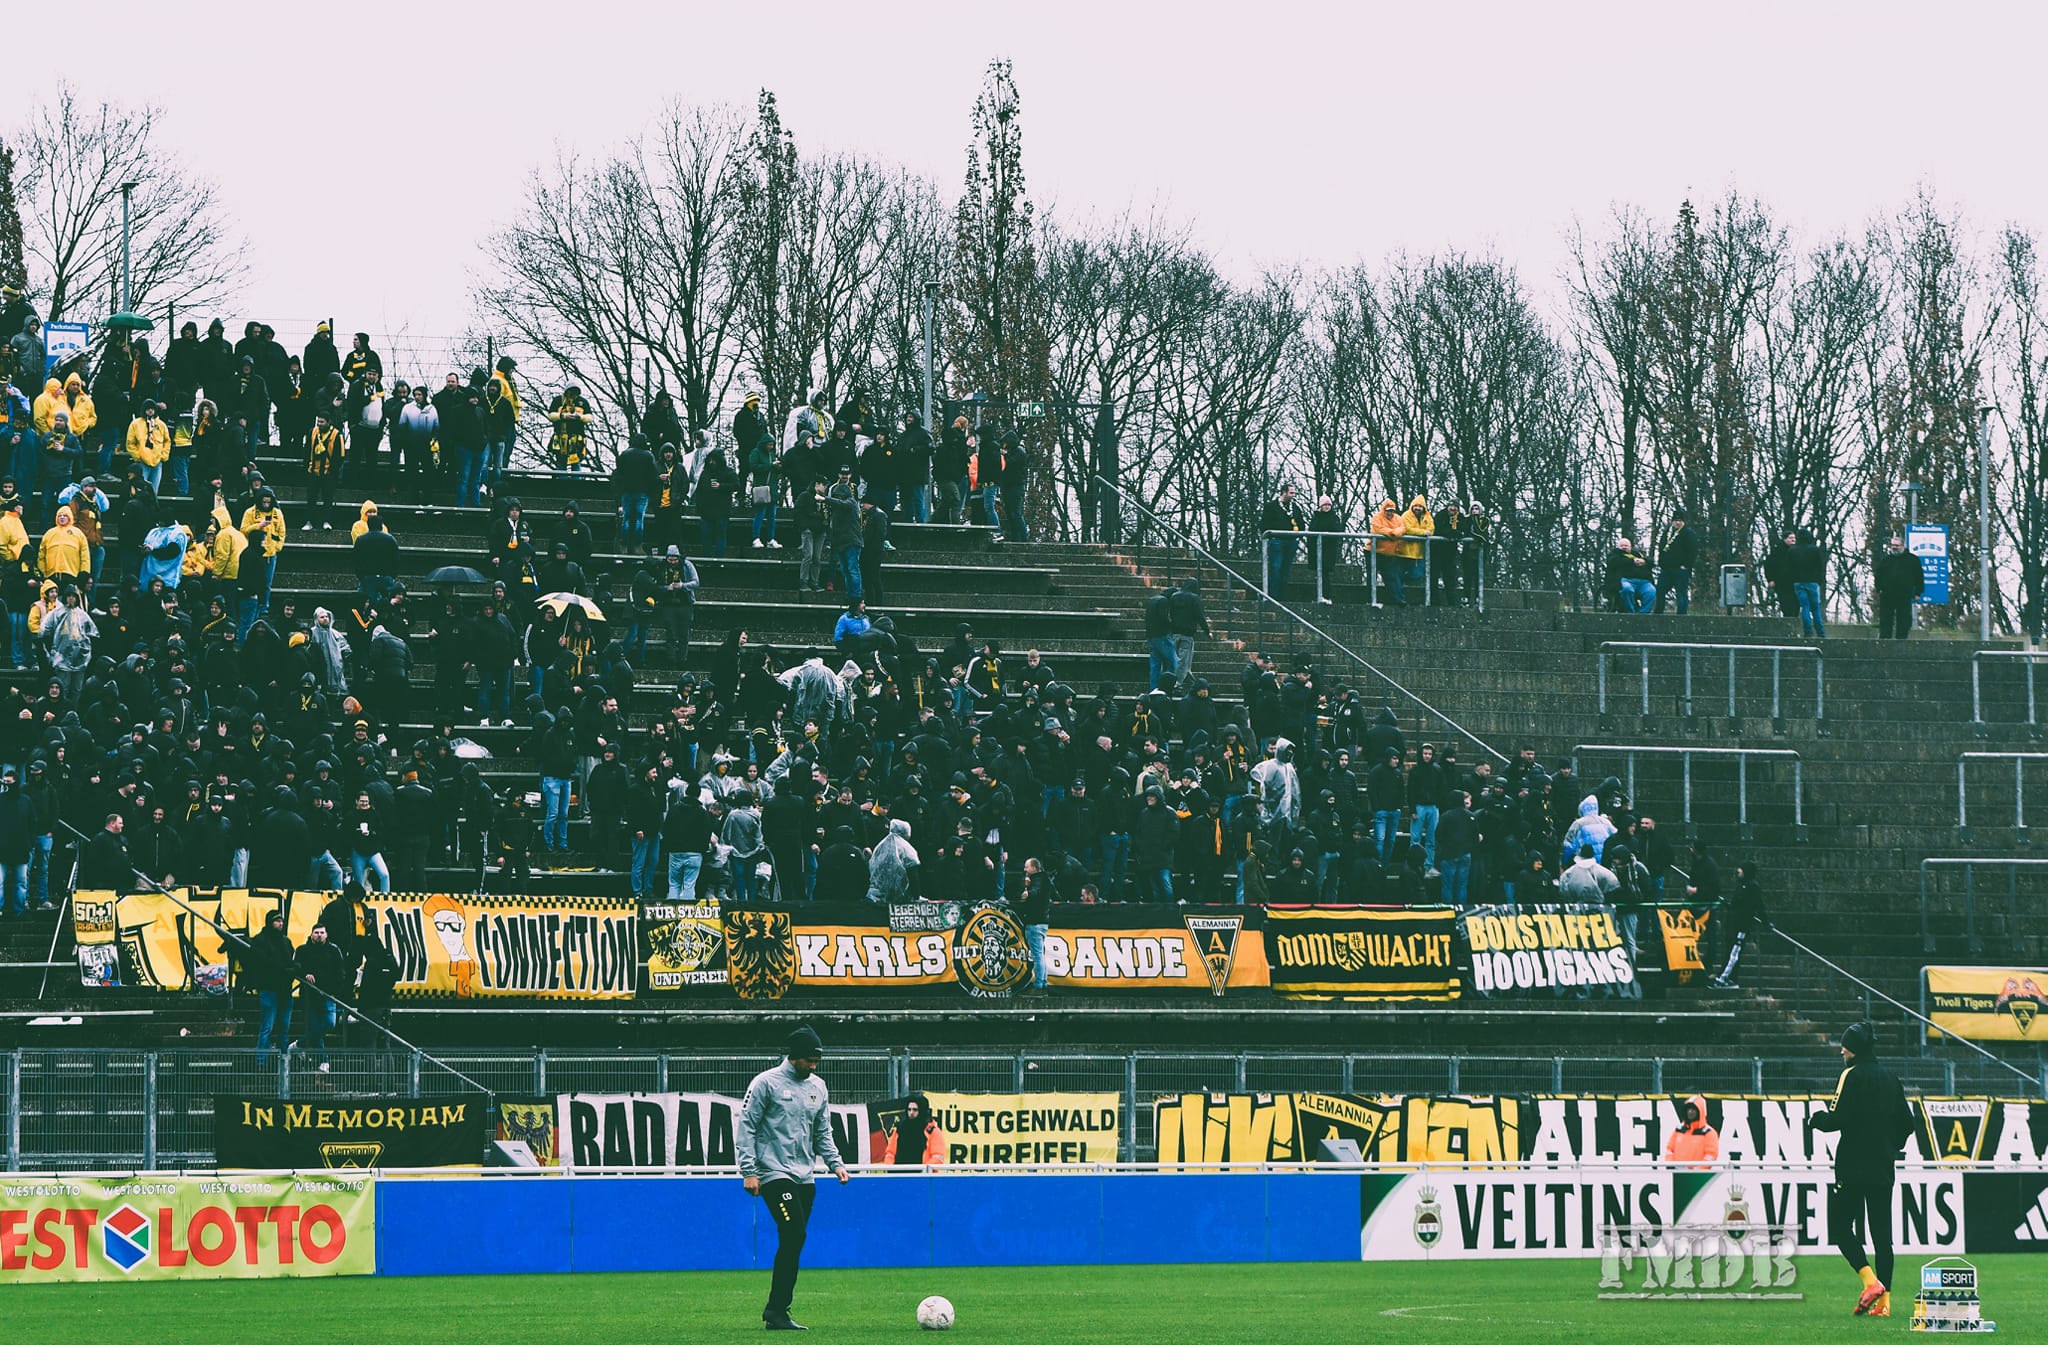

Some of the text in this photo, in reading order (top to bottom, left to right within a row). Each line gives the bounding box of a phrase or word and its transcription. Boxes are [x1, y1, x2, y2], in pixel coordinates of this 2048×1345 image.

[645, 904, 720, 919] FÜR STADT
[1192, 919, 1238, 929] ALEMANNIA
[1208, 931, 1226, 952] A
[1466, 913, 1623, 951] BOXSTAFFEL
[475, 913, 637, 994] CONNECTION
[796, 935, 945, 977] KARLS
[1045, 936, 1187, 978] BANDE
[1277, 933, 1451, 967] DOM WACHT
[653, 973, 681, 986] UND
[1472, 947, 1633, 991] HOOLIGANS
[1934, 996, 1994, 1010] Tivoli Tigers
[929, 1104, 1115, 1134] HÜRTGENWALD
[1299, 1095, 1374, 1127] ALEMANNIA
[1929, 1103, 1984, 1113] ALEMANNIA
[328, 1146, 376, 1156] Alemannia
[1947, 1120, 1968, 1152] A
[1453, 1183, 1663, 1249] VELTINS
[1761, 1182, 1958, 1246] VENS
[158, 1203, 347, 1266] LOTTO
